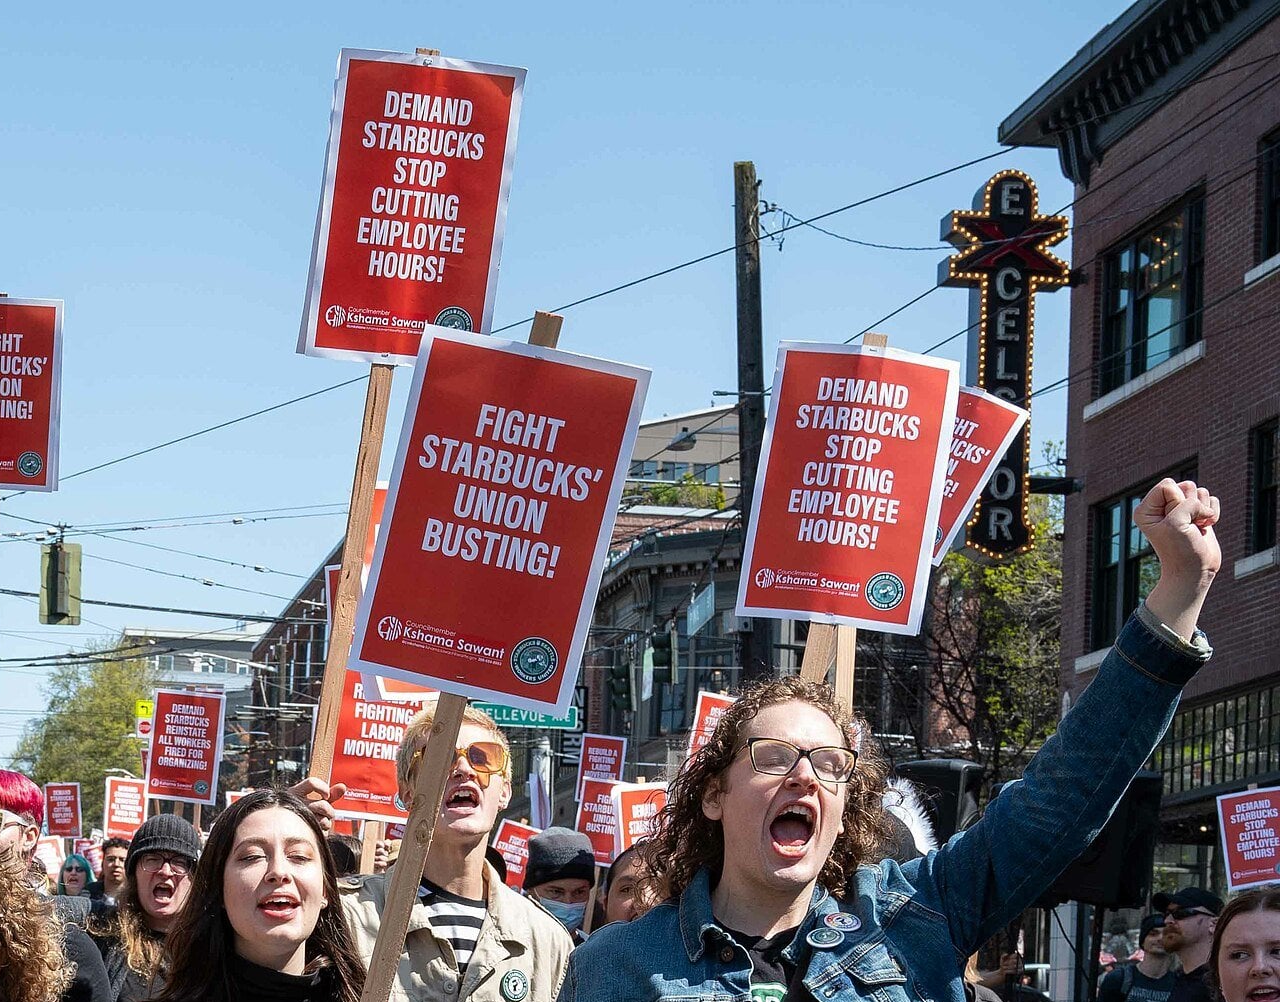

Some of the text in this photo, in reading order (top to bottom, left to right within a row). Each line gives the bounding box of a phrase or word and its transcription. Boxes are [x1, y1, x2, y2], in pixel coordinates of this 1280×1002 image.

[383, 90, 473, 126] DEMAND
[362, 120, 485, 161] STARBUCKS
[393, 156, 447, 188] STOP
[371, 186, 460, 222] CUTTING
[357, 217, 466, 254] EMPLOYEE
[368, 250, 446, 283] HOURS!
[346, 310, 389, 326] Kshama
[348, 306, 390, 316] Councilmember
[817, 377, 909, 410] DEMAND
[475, 403, 566, 453] FIGHT
[796, 404, 921, 441] STARBUCKS
[824, 434, 882, 463] STOP
[418, 434, 604, 502] STARBUCKS'
[802, 461, 894, 495] CUTTING
[453, 483, 548, 534] UNION
[787, 489, 901, 525] EMPLOYEE
[797, 518, 880, 550] HOURS!
[421, 517, 561, 579] BUSTING!
[776, 573, 816, 588] Kshama
[818, 576, 861, 594] Sawant
[406, 620, 456, 637] Councilmember
[404, 626, 453, 648] Kshama
[458, 638, 505, 659] Sawant
[172, 704, 205, 716] DEMAND
[164, 714, 210, 727] STARBUCKS
[166, 724, 206, 737] REINSTATE
[158, 734, 211, 750] ALL WORKERS
[361, 722, 404, 742] LABOR
[164, 746, 203, 759] FIRED FOR
[588, 747, 612, 756] REBUILD
[588, 755, 616, 764] FIGHTING
[158, 757, 207, 770] ORGANIZING!
[592, 763, 611, 772] LABOR
[1230, 808, 1278, 824] STARBUCKS
[1235, 800, 1271, 813] DEMAND
[1239, 828, 1275, 842] CUTTING
[1244, 820, 1266, 831] STOP
[1237, 837, 1280, 852] EMPLOYEE
[1244, 848, 1276, 860] HOURS!
